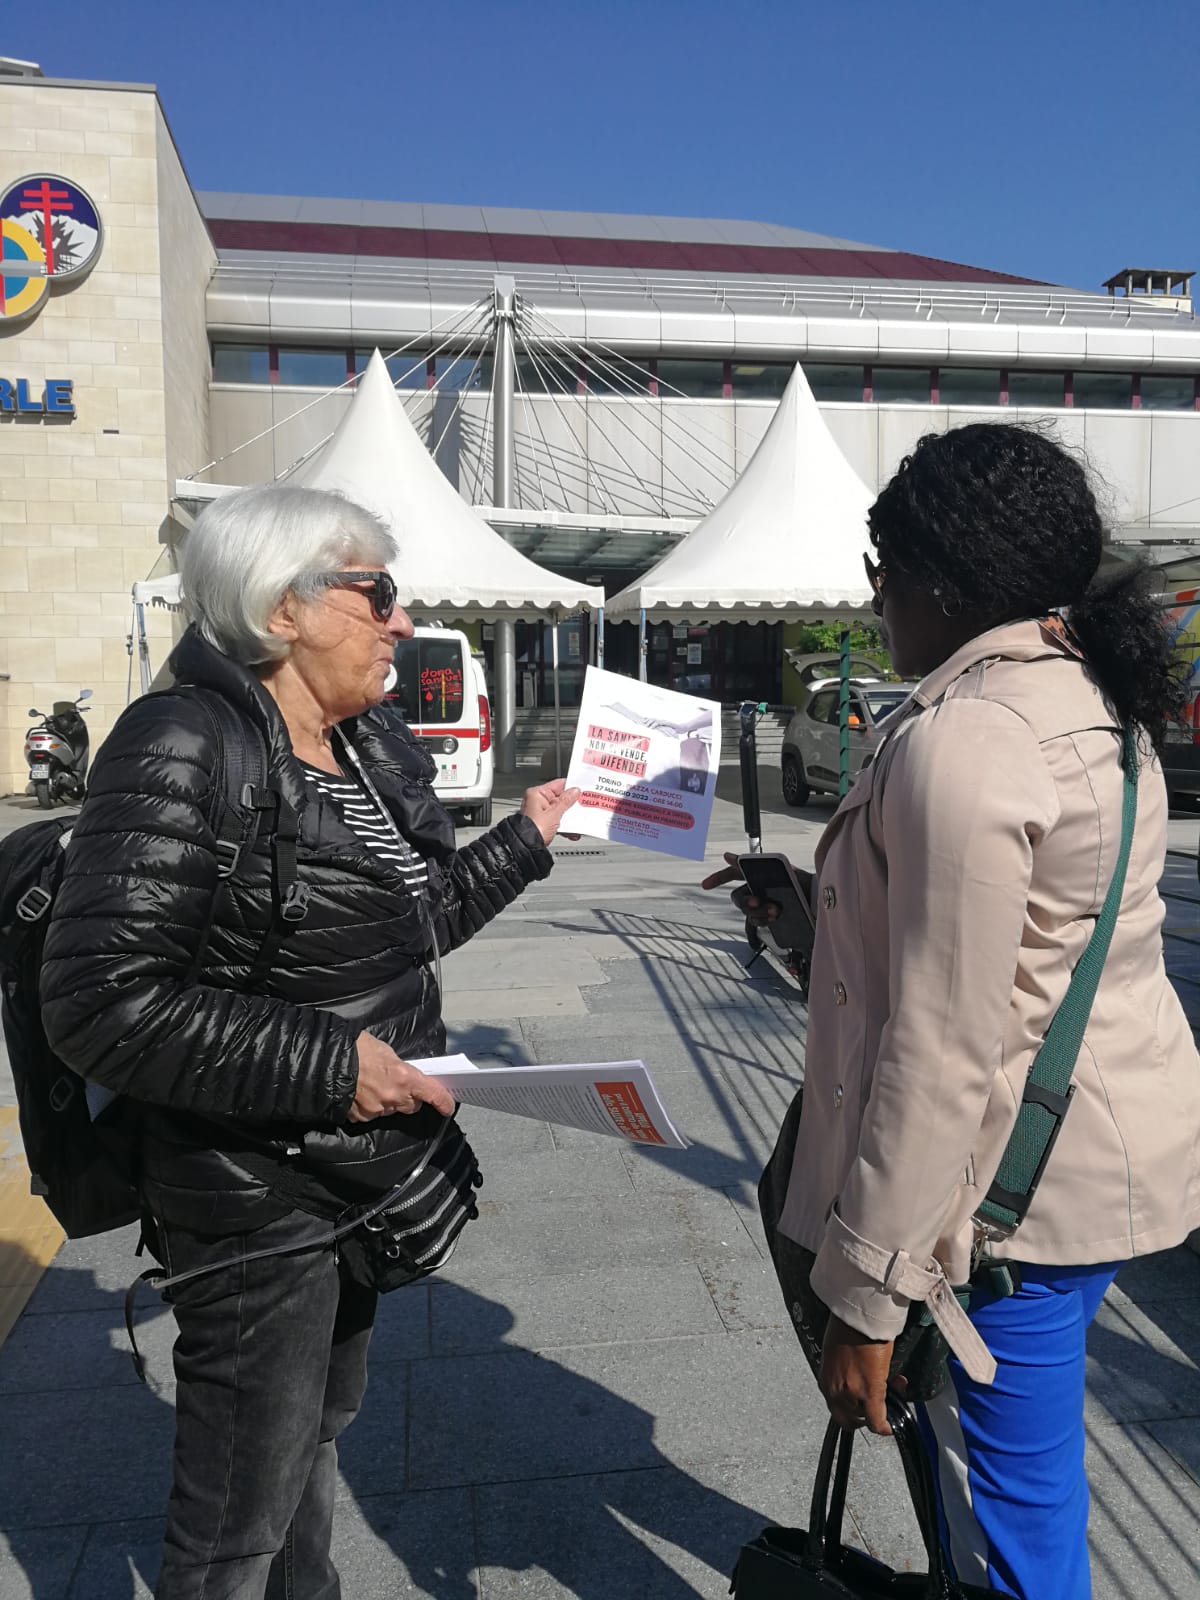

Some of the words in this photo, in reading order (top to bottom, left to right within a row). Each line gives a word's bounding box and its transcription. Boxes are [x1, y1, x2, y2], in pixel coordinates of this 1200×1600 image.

[591, 727, 603, 739] LA
[590, 739, 606, 751] NON
[598, 776, 622, 787] TORINO
